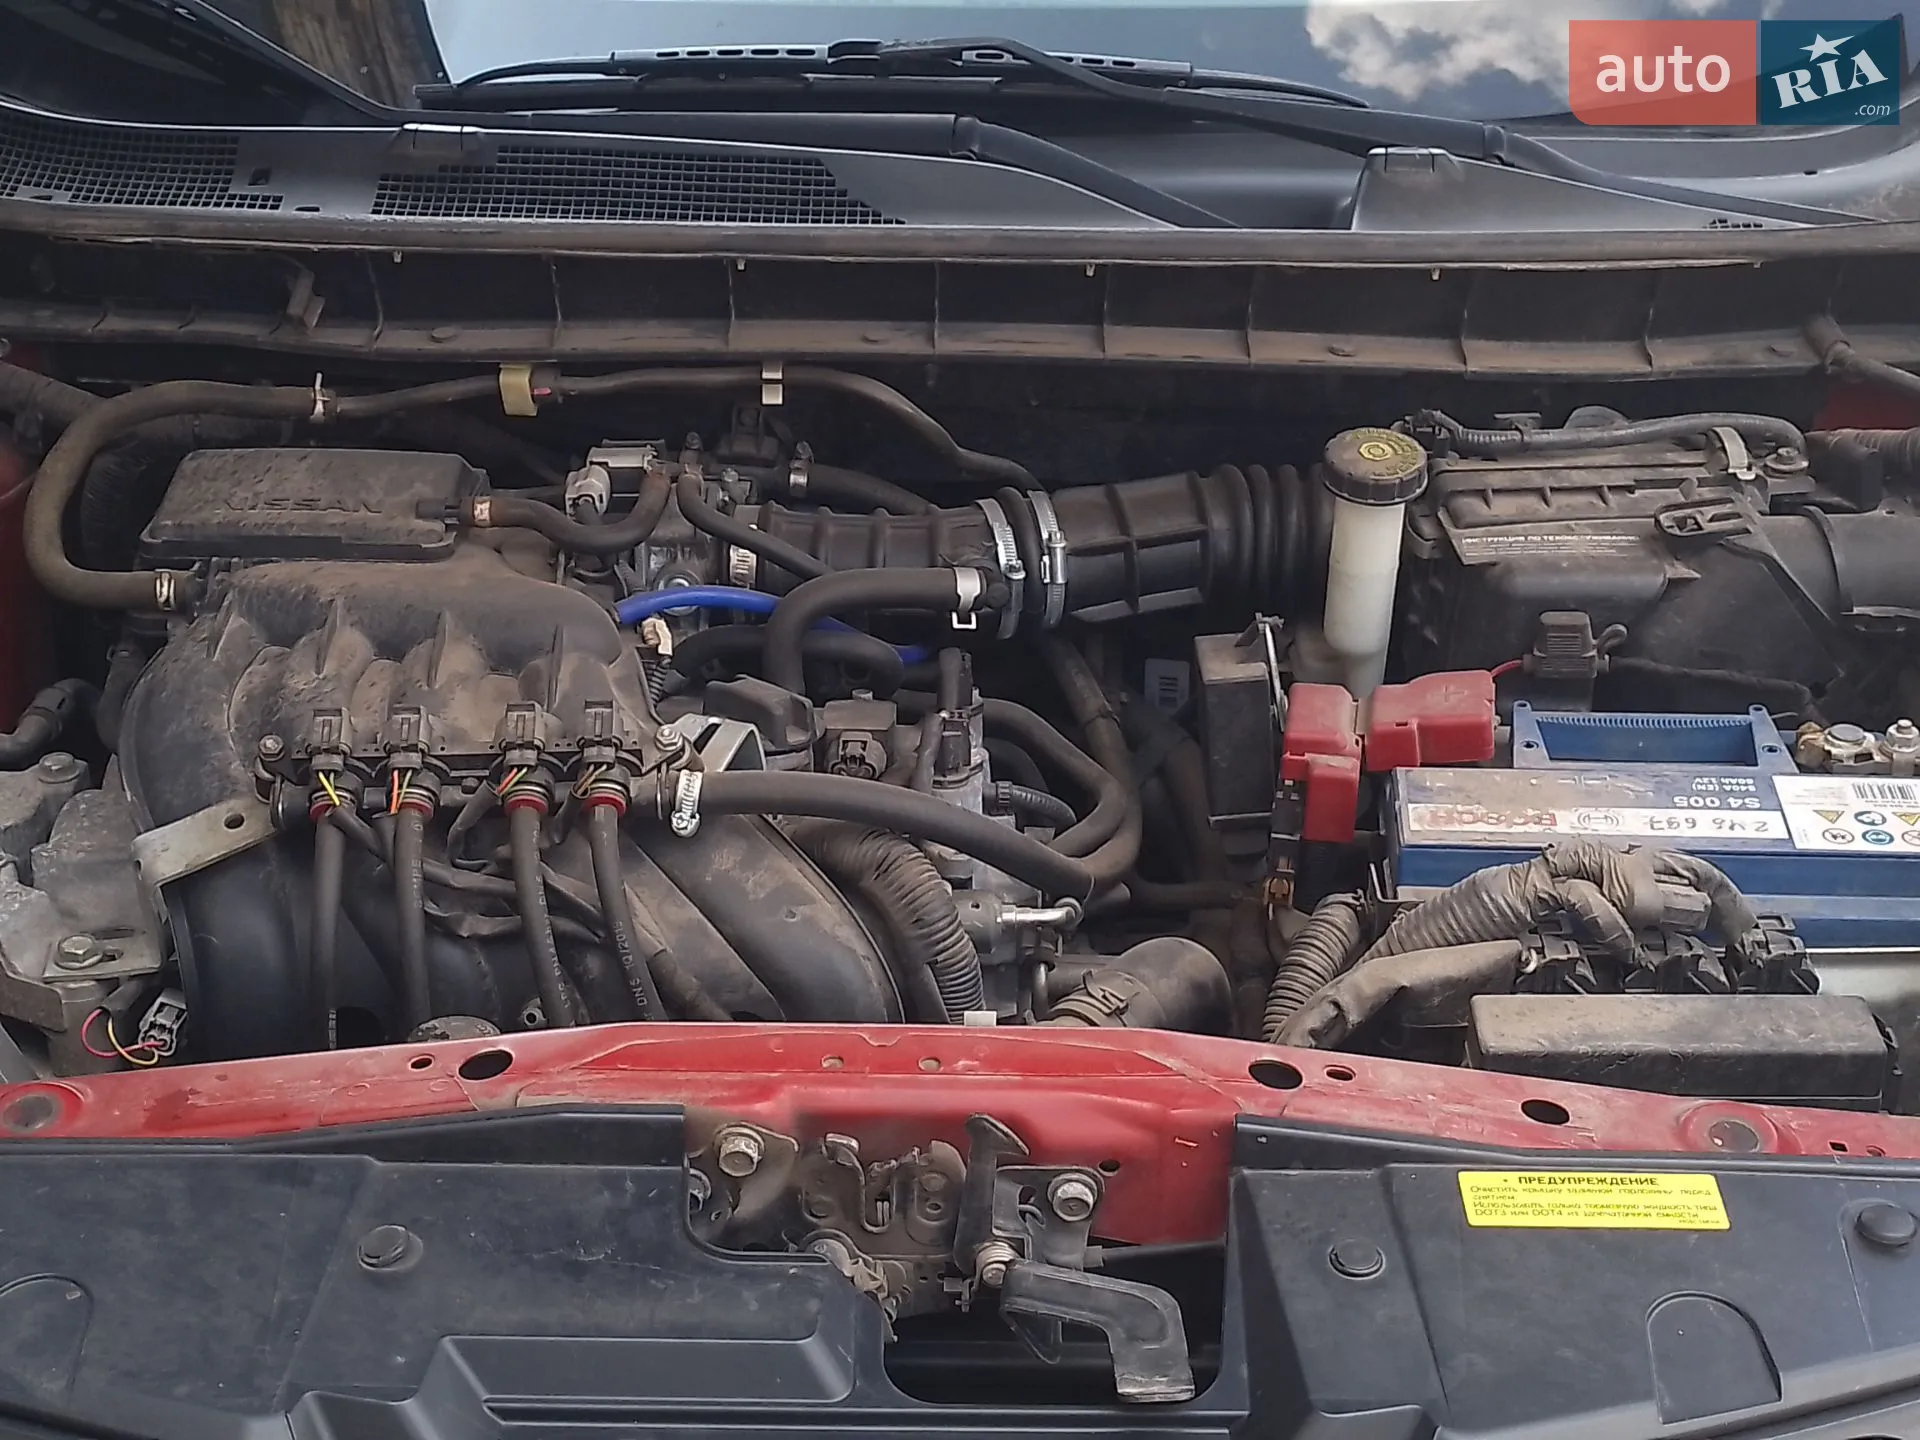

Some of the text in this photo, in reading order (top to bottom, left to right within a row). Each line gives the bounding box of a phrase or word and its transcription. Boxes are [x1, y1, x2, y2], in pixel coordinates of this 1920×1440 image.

[1673, 795, 1761, 809] S4 005
[1518, 1176, 1659, 1186] ПРЕДУПРЕЖДЕНИЕ
